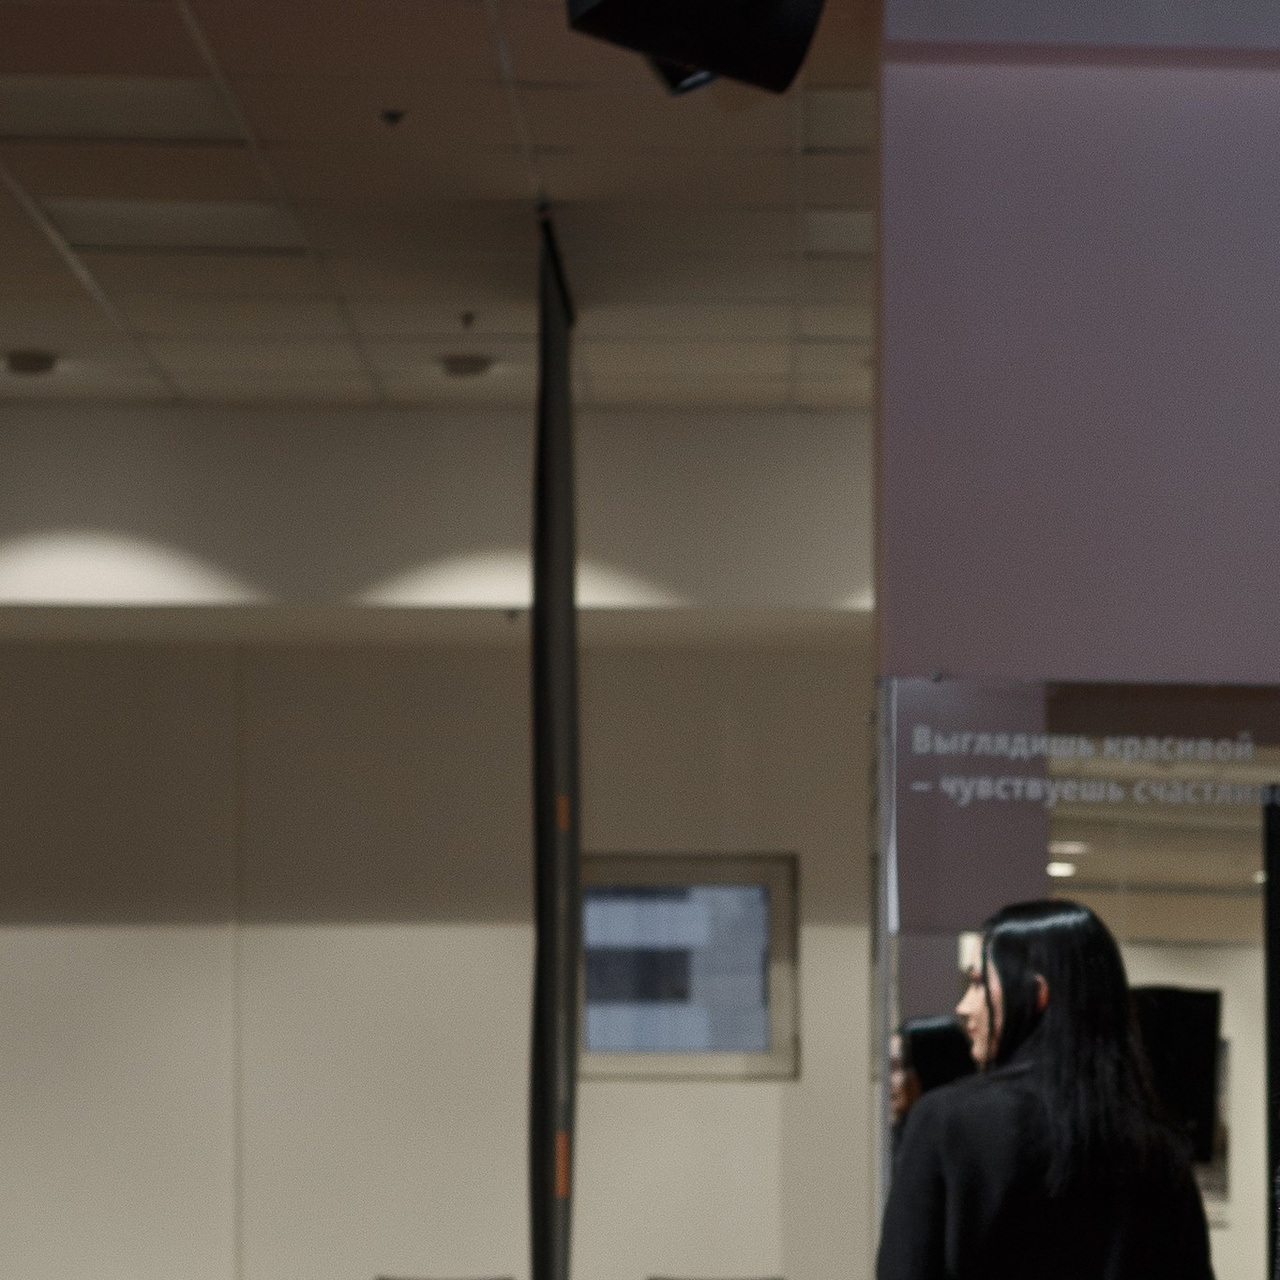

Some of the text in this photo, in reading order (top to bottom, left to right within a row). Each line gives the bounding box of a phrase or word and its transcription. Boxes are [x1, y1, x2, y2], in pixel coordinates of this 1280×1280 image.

[911, 724, 1254, 763] Выглядишь красивой
[940, 776, 1124, 808] чувствуешь
